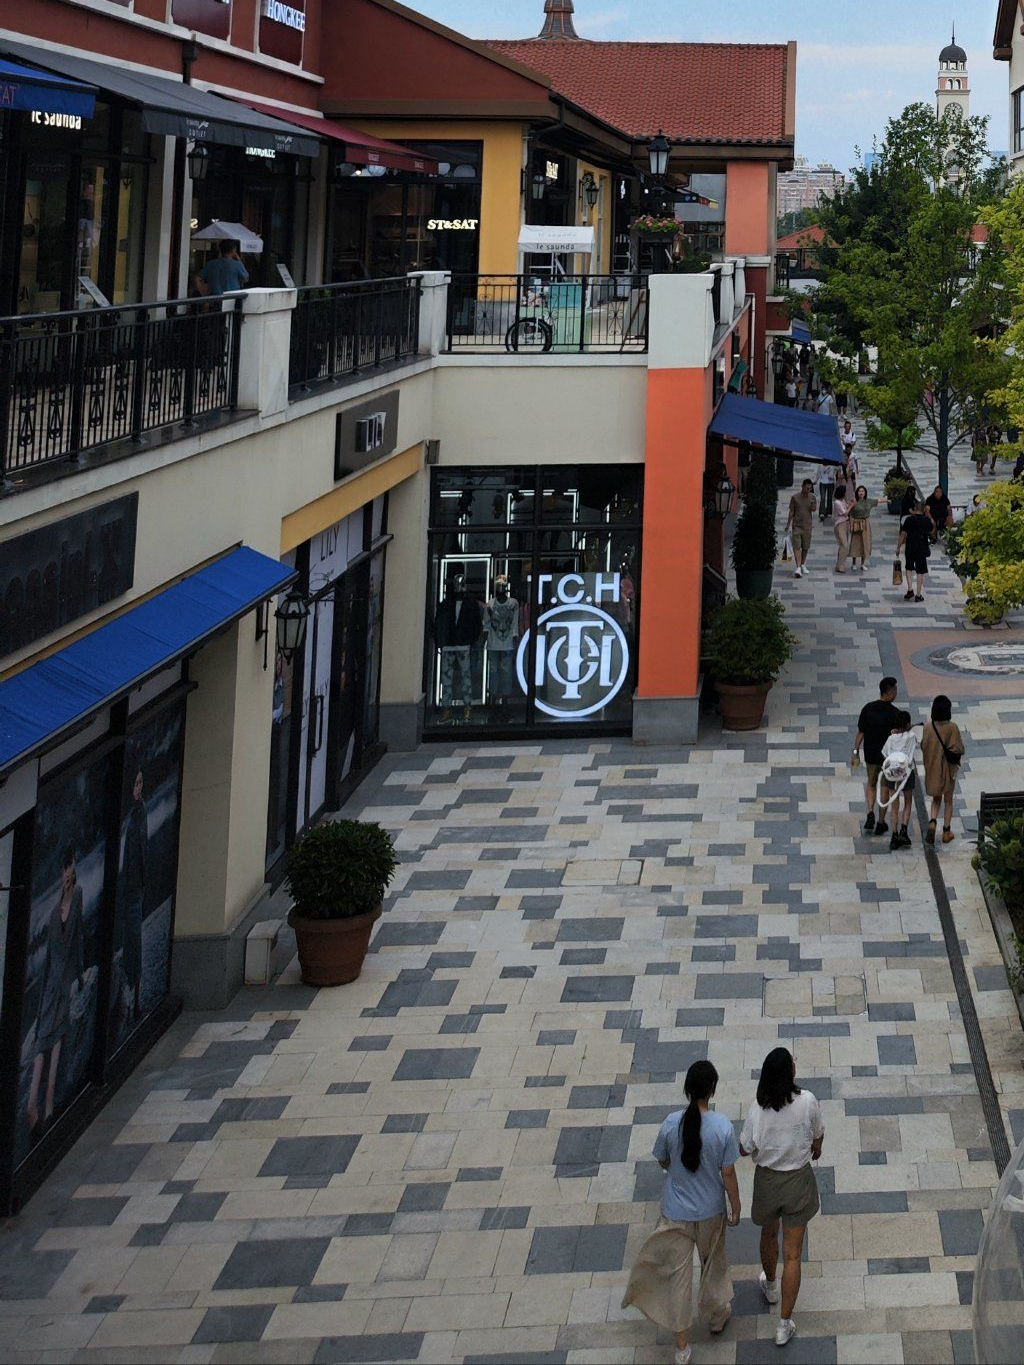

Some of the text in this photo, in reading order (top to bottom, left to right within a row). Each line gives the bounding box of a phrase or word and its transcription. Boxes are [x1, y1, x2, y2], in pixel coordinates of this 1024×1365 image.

[427, 219, 478, 230] ST&SAT
[361, 412, 386, 452] LILY
[320, 523, 340, 562] LILY
